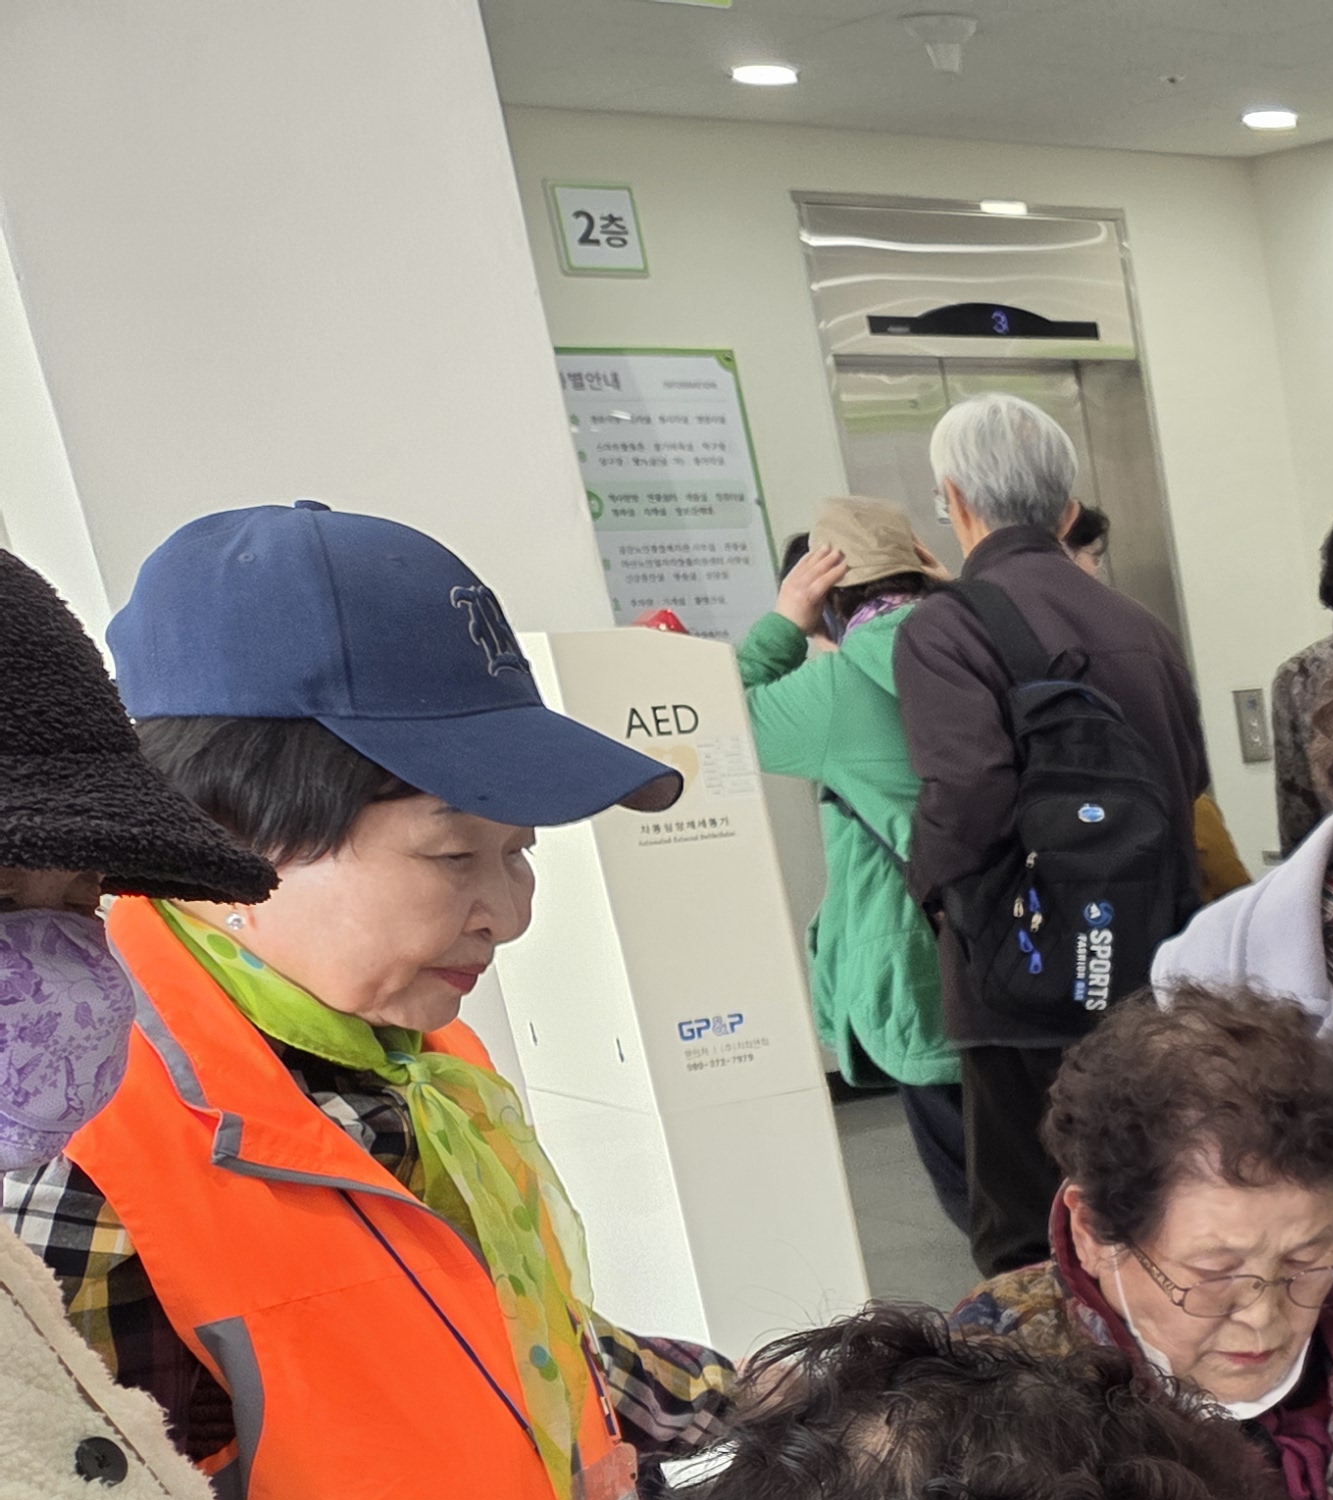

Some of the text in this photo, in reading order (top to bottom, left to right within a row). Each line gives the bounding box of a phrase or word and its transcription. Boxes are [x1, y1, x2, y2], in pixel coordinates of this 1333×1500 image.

[572, 210, 629, 248] 2층
[991, 310, 1009, 335] 3
[559, 371, 621, 391] 별안내
[626, 704, 699, 738] AED
[1076, 933, 1086, 979] FASHION
[1086, 929, 1113, 1011] SPORTS
[678, 1013, 743, 1042] GP&P
